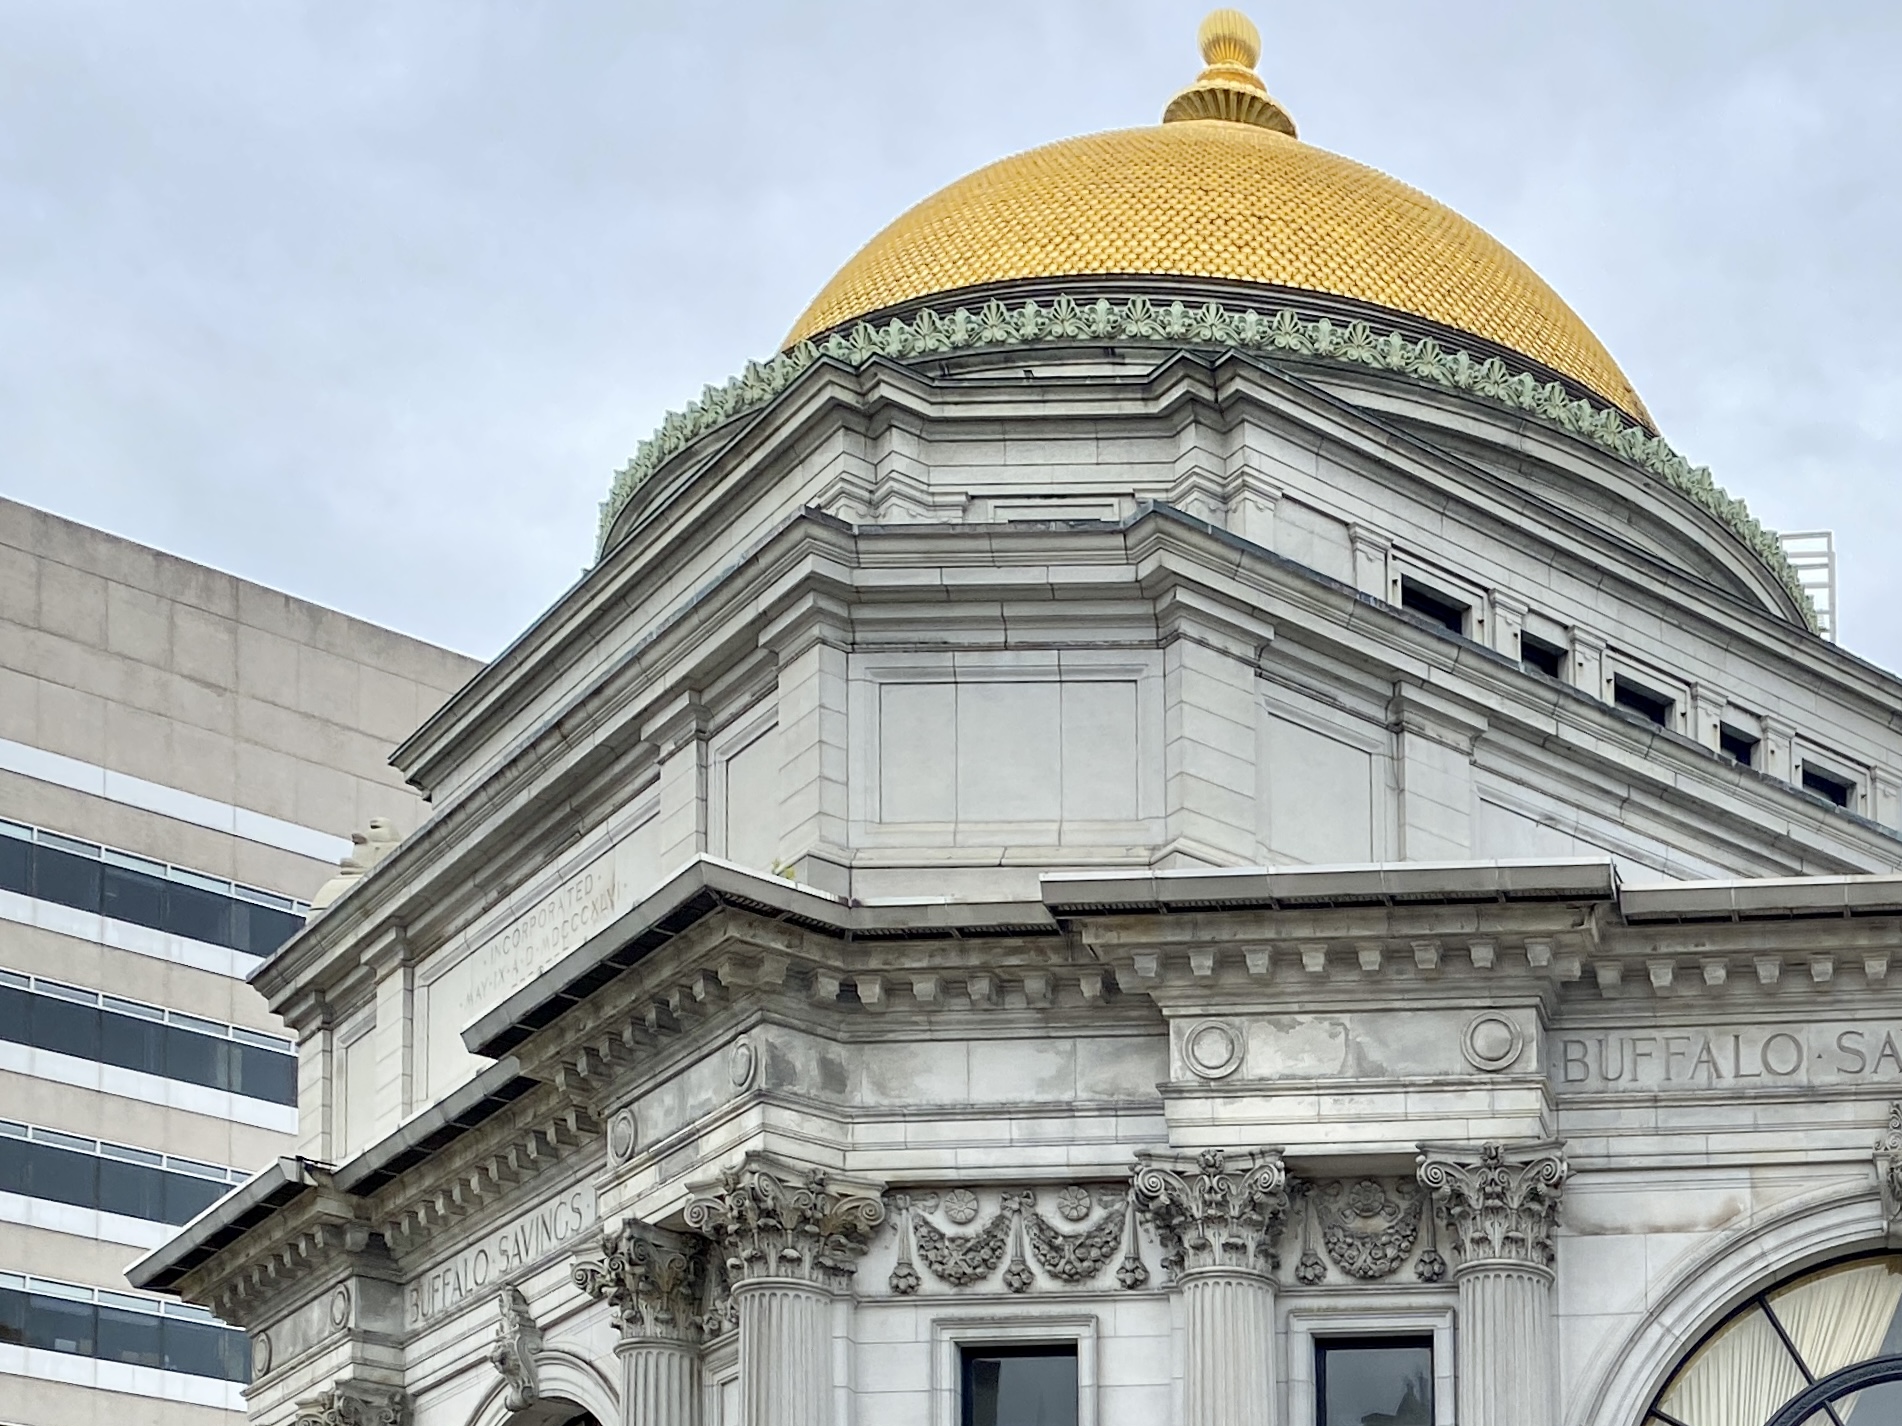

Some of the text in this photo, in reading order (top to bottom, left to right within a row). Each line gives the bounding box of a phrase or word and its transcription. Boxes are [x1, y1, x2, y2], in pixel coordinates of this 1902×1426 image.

[490, 873, 594, 961] INCORPORATED
[1562, 1032, 1804, 1083] BUFFALO
[410, 1192, 583, 1324] BUFFALO SAVINGS
